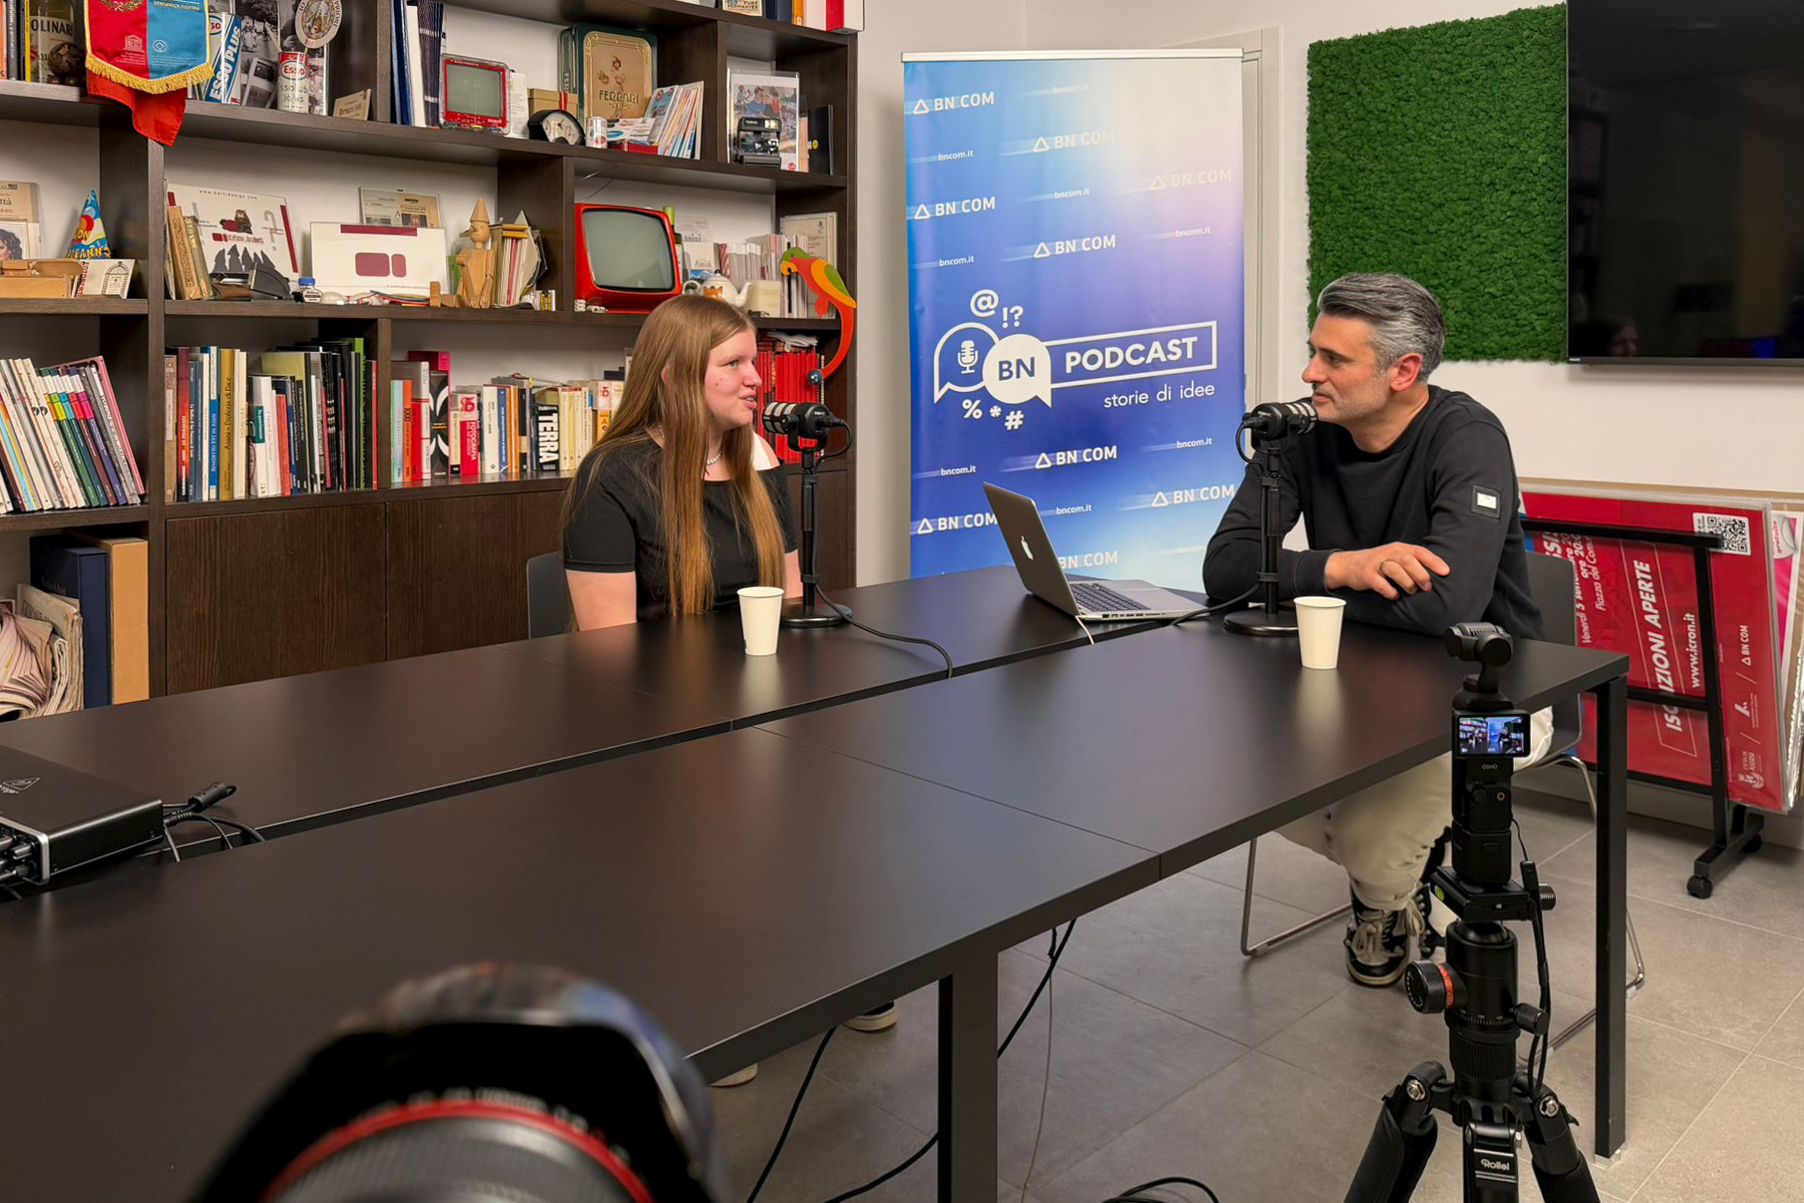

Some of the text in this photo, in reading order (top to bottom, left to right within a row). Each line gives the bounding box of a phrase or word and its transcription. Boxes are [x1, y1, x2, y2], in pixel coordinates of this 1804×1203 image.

[31, 19, 74, 37] OLINARI
[210, 22, 222, 30] SO
[209, 25, 241, 101] ESSO PLUS
[1053, 82, 1089, 95] bncom.it
[934, 91, 995, 112] BN COM
[1054, 130, 1115, 149] BN COM
[938, 150, 974, 162] bncom.it
[1171, 168, 1232, 187] BN COM
[1054, 187, 1090, 199] bncom.it
[935, 197, 996, 217] BN COM
[1175, 226, 1211, 238] bncom.it
[1054, 235, 1116, 255] BN COM
[939, 255, 975, 267] bncom.it
[998, 336, 1198, 382] BN PODCAST
[1104, 380, 1216, 408] storie di idee
[538, 413, 559, 464] TERRA
[1176, 437, 1212, 449] bncom.it
[1056, 445, 1118, 466] BN COM
[940, 464, 977, 477] bncom.it
[1173, 484, 1235, 504] BN COM
[1056, 503, 1092, 515] bncom.it
[937, 512, 998, 531] BN COM
[1059, 551, 1118, 569] BN COM
[1579, 560, 1589, 579] ore
[1588, 564, 1600, 580] del
[1593, 580, 1606, 611] Piazza
[1575, 603, 1585, 611] 5
[1633, 560, 1683, 732] ISCIZIONI APERTE
[1739, 625, 1751, 656] BN COM
[1683, 612, 1700, 689] www.icron.it
[1481, 1158, 1510, 1171] Rollei
